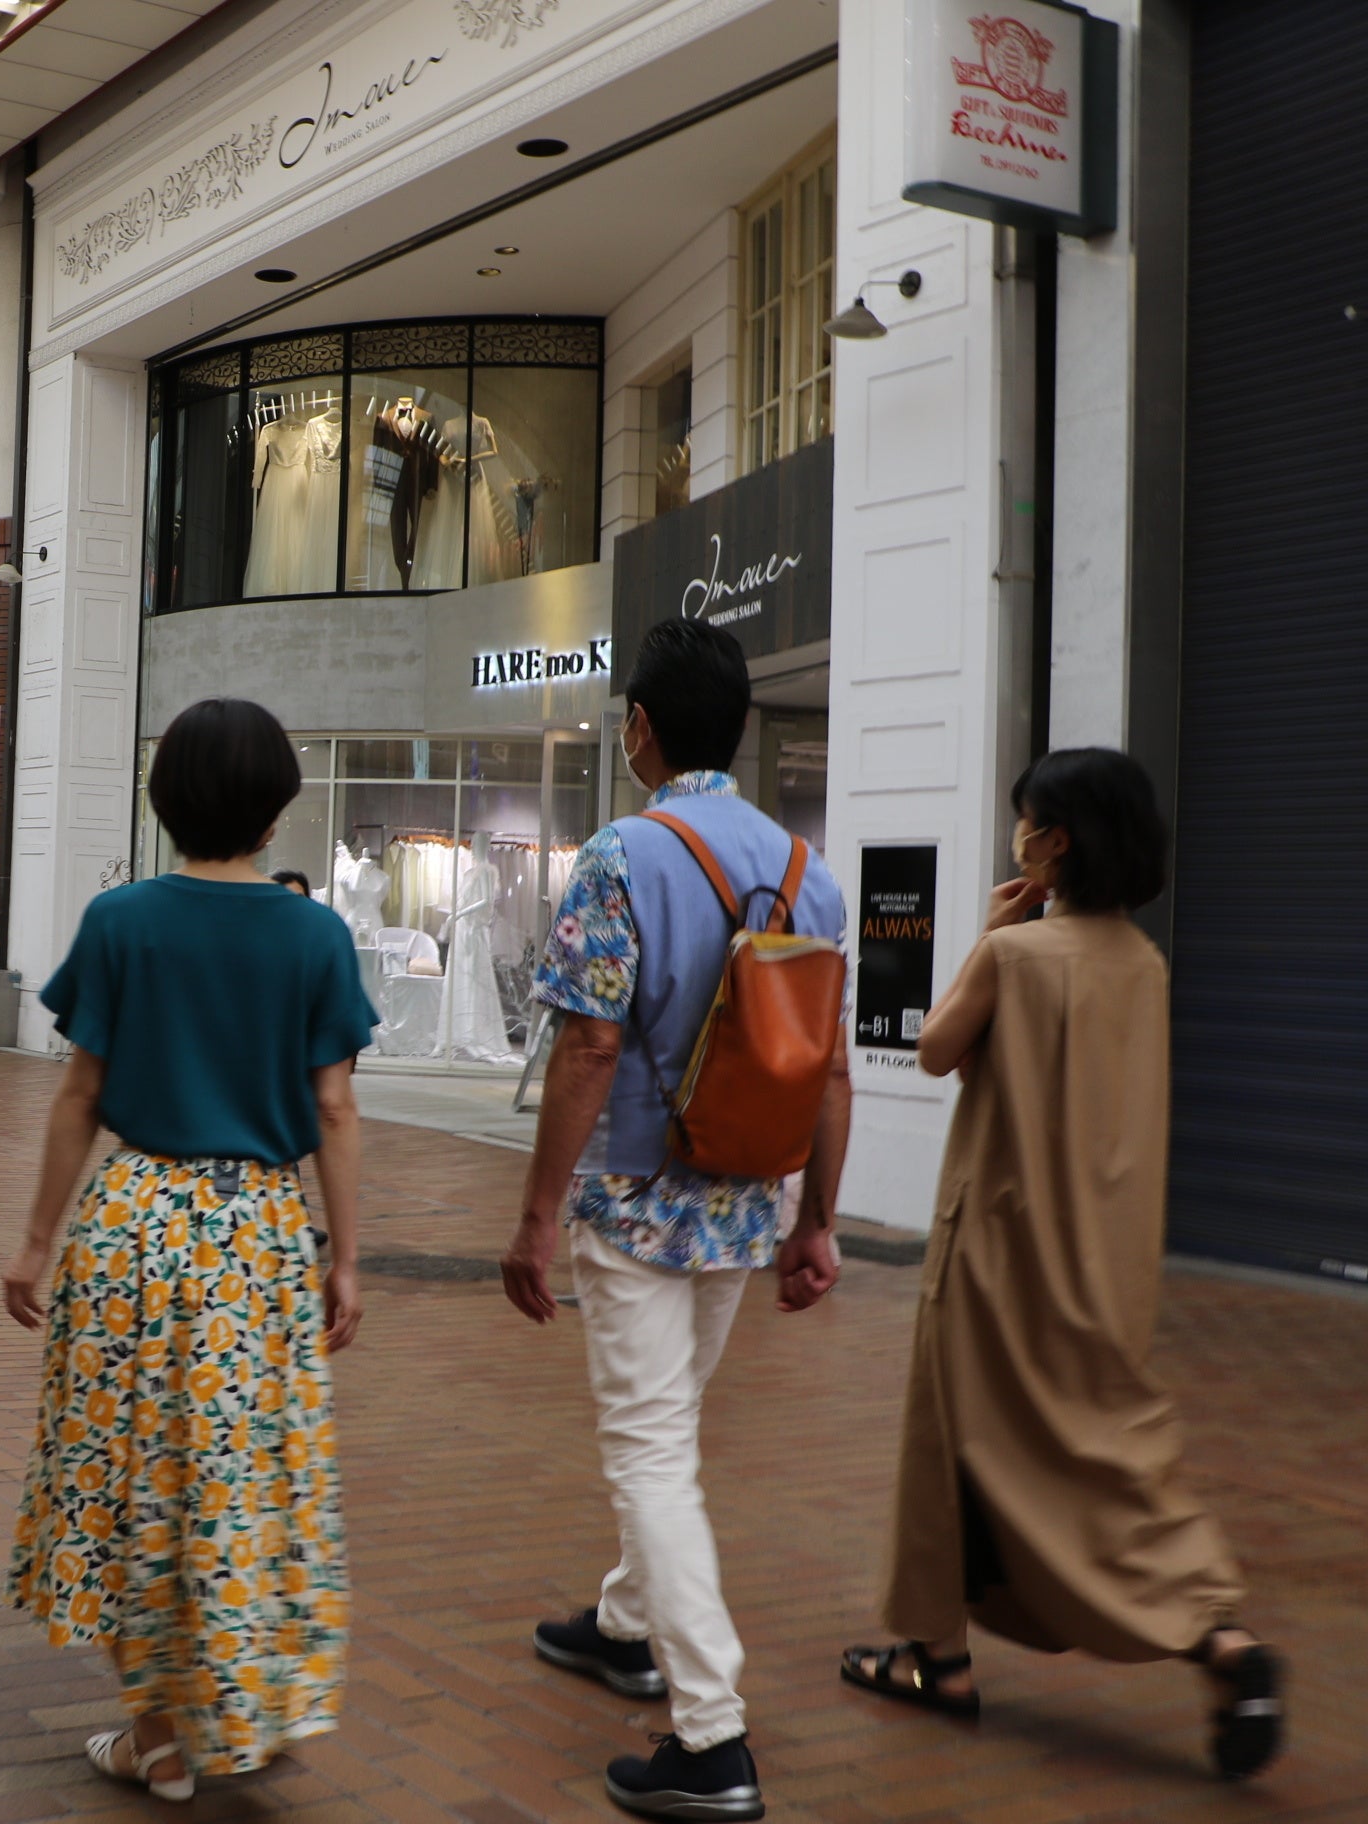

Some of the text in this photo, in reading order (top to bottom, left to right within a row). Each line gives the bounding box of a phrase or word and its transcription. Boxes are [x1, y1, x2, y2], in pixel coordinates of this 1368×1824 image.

[738, 599, 762, 619] SALON
[471, 650, 542, 686] HARE
[546, 653, 583, 678] mo
[863, 916, 932, 941] ALWAYS
[873, 1015, 890, 1038] B1
